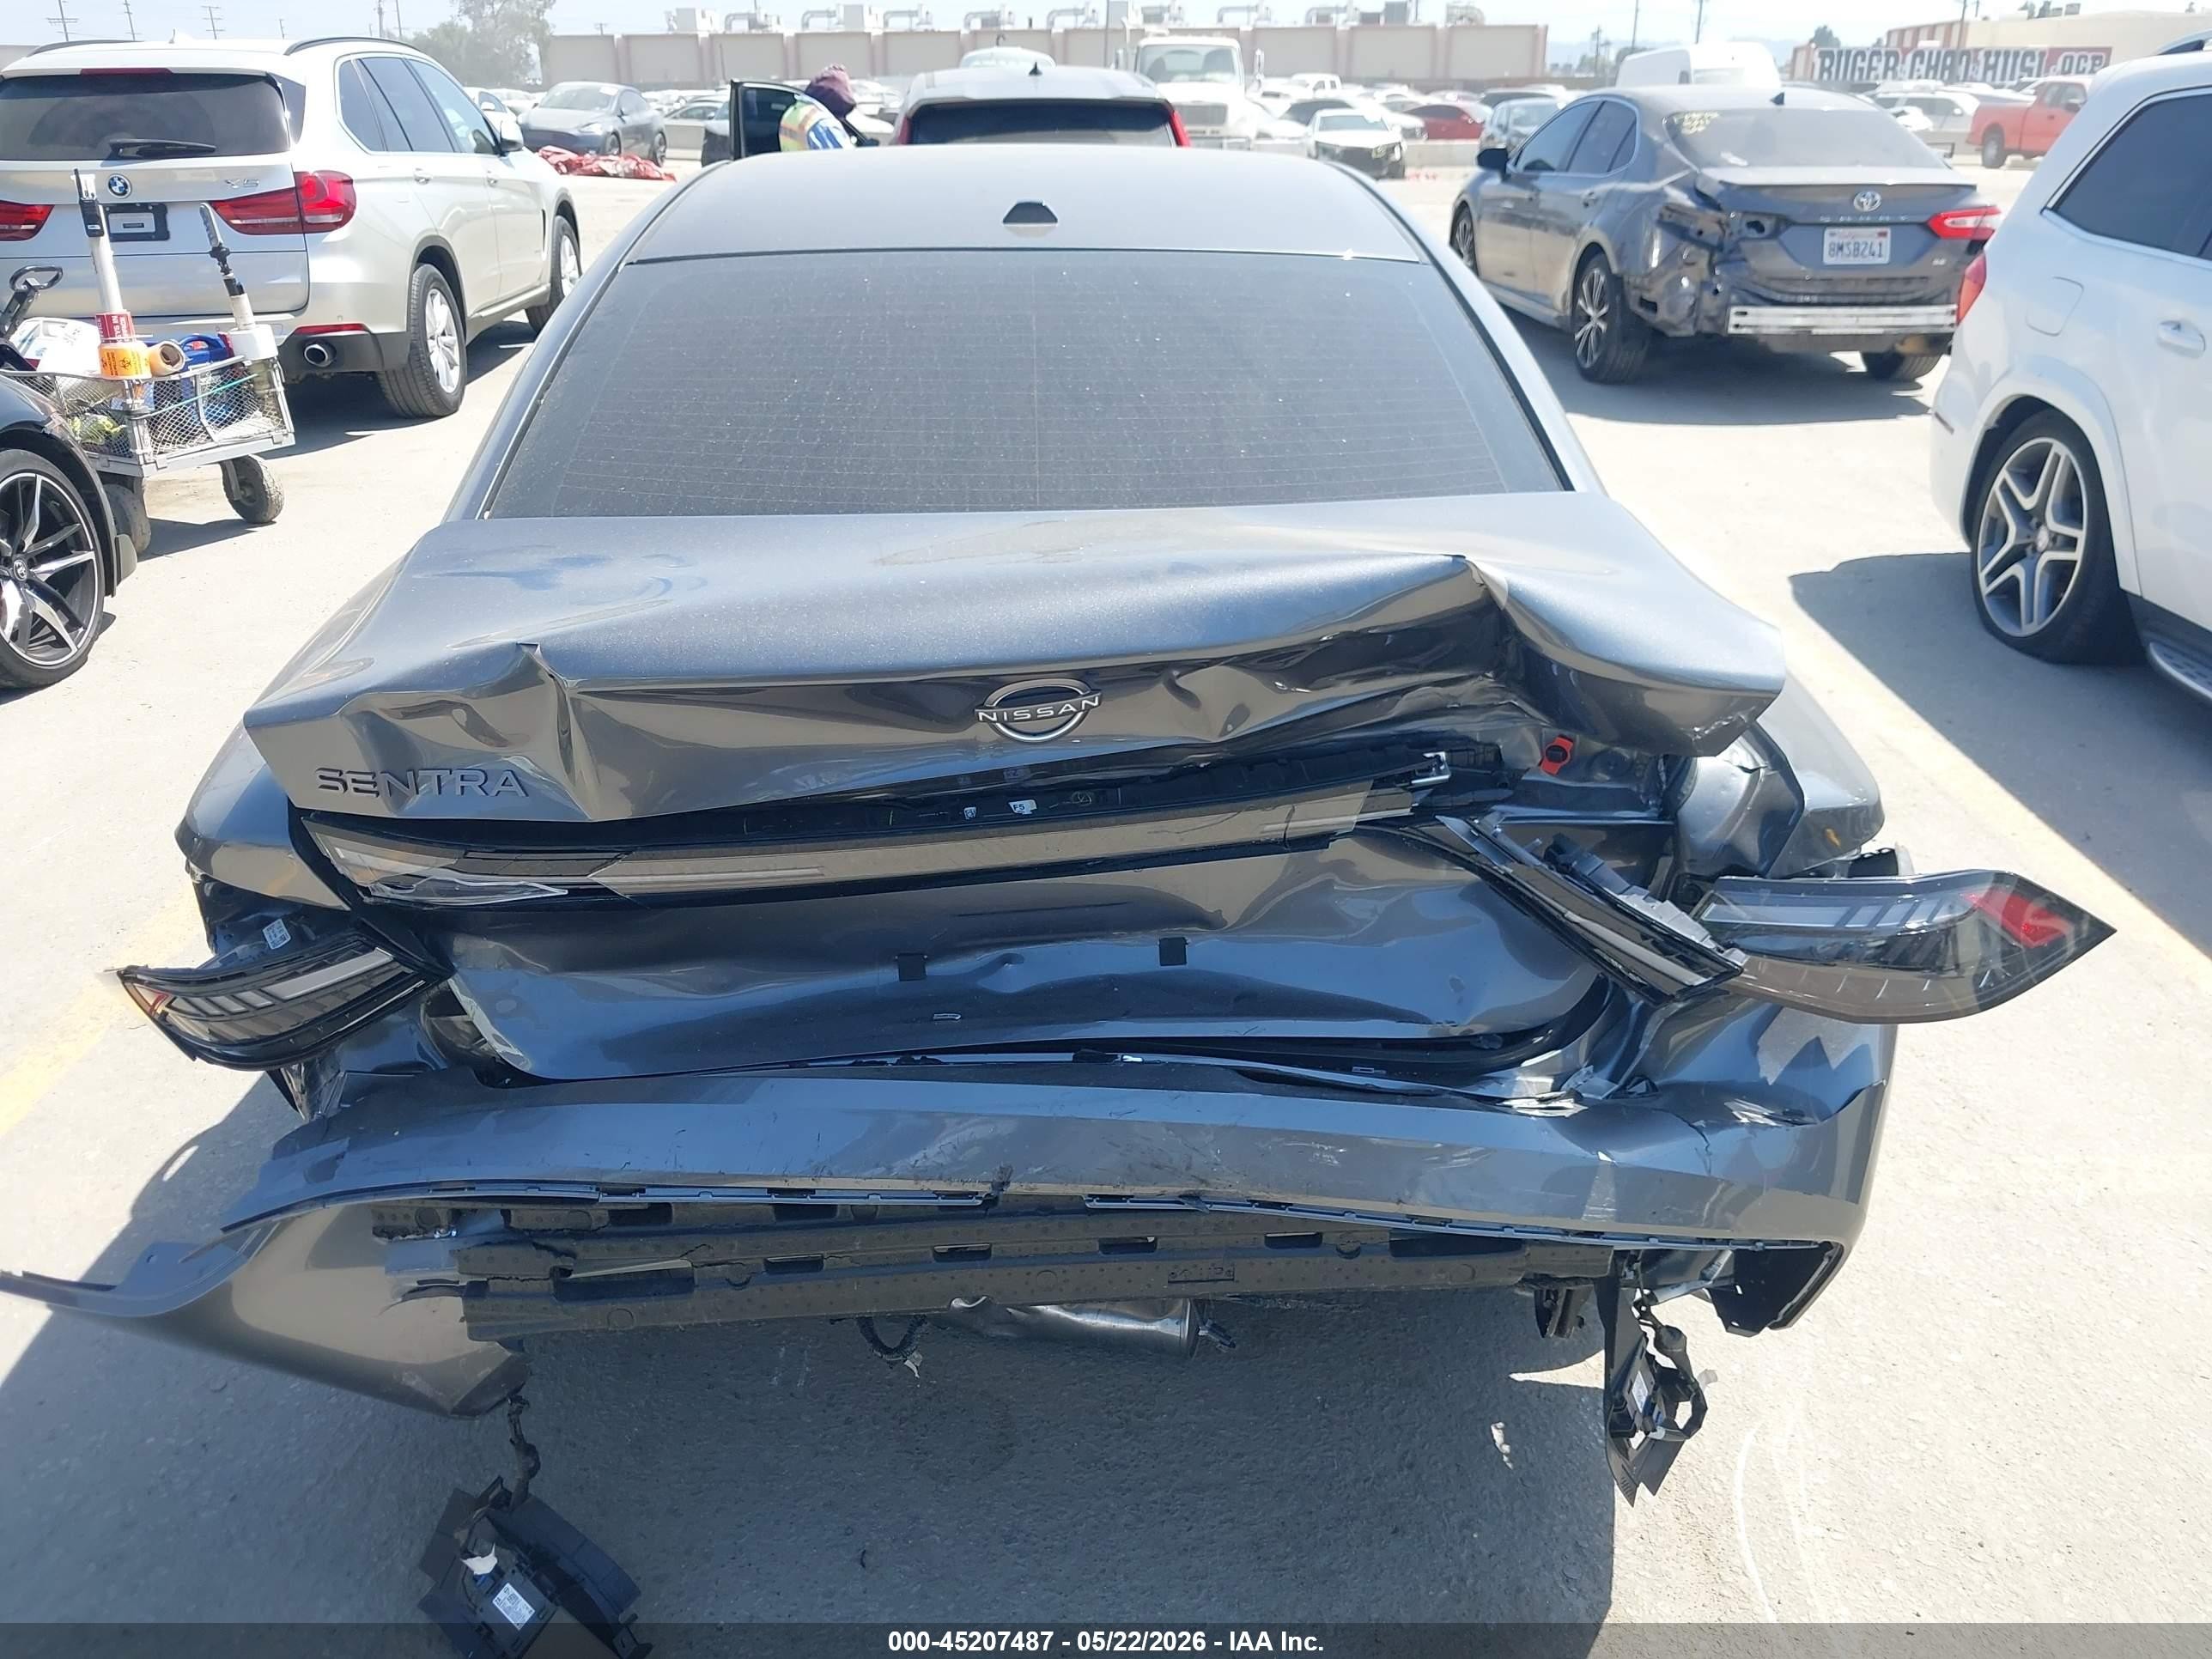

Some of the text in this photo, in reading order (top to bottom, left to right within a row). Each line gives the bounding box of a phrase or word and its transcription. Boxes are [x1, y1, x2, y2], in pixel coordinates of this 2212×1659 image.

[225, 178, 260, 189] X5
[1828, 240, 1884, 258] 8MSB241
[978, 696, 1100, 722] NISSAN
[314, 767, 530, 799] SENTRA
